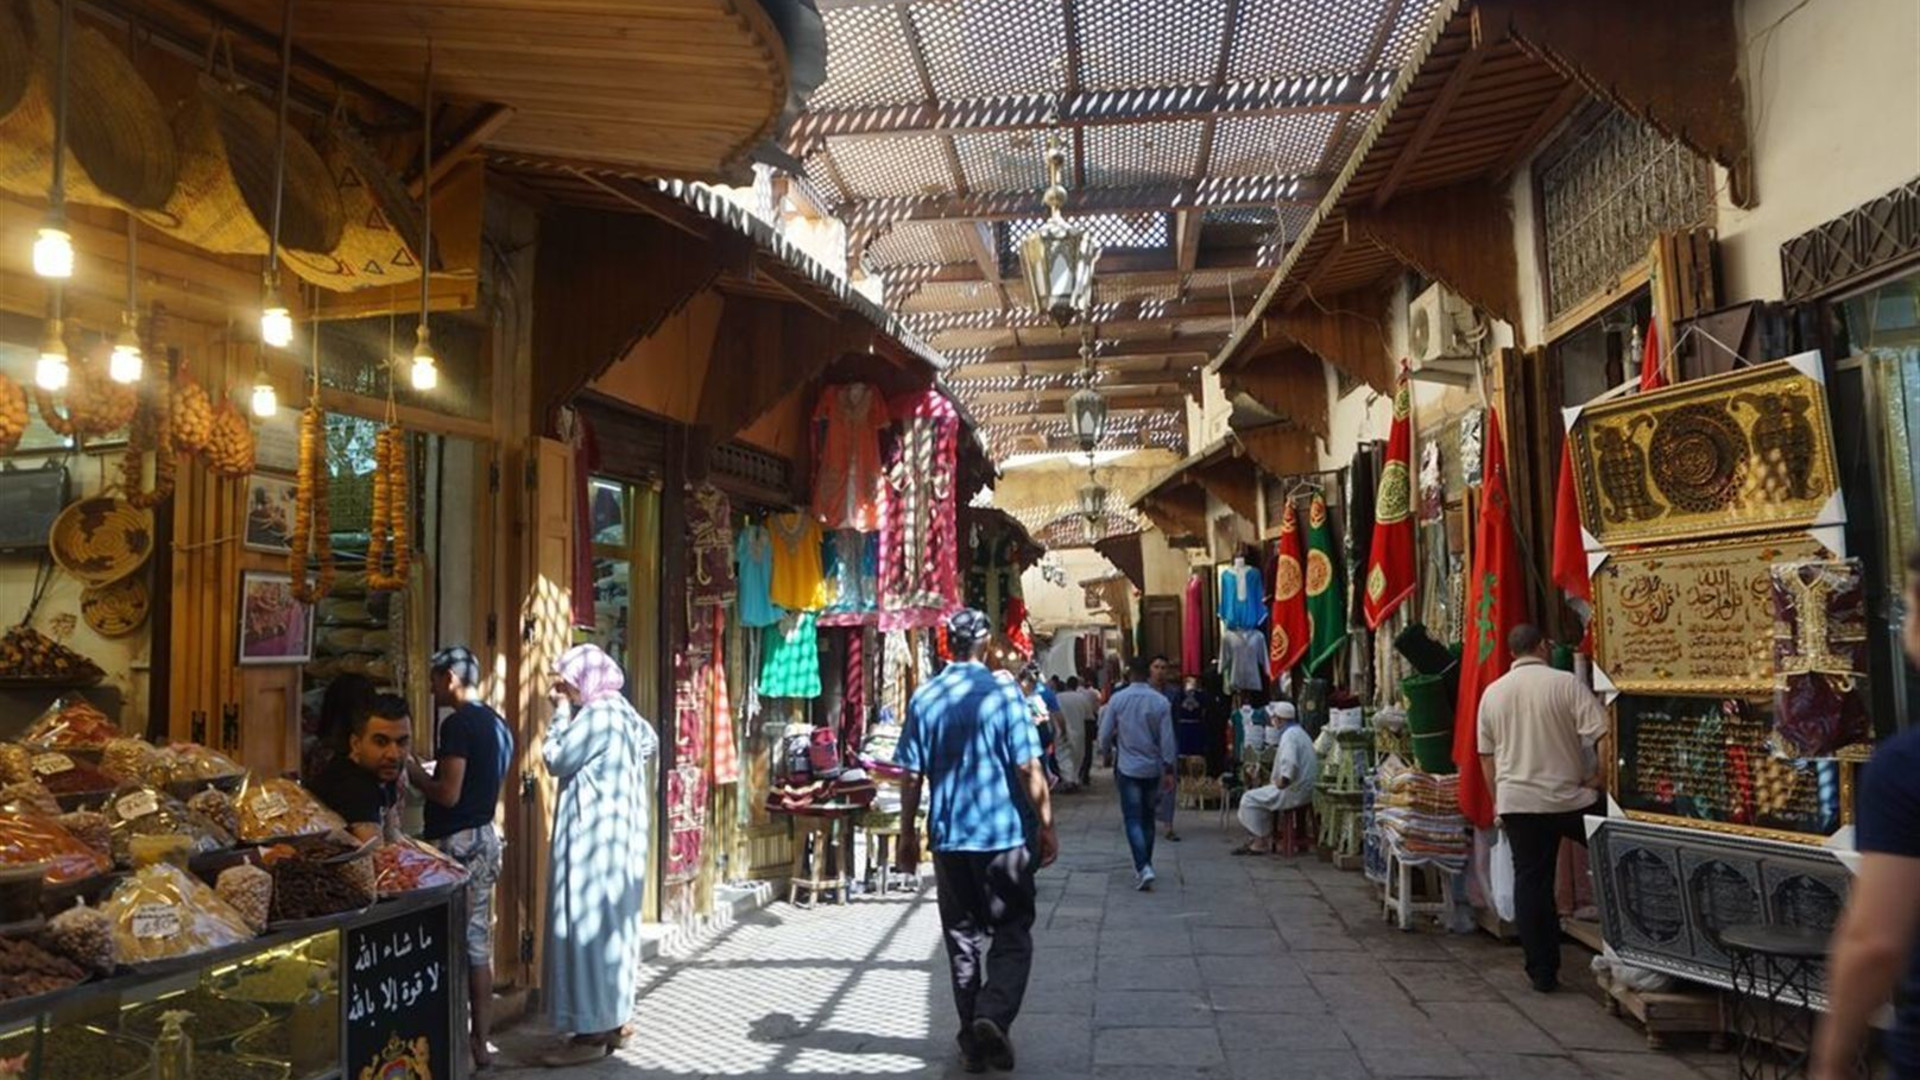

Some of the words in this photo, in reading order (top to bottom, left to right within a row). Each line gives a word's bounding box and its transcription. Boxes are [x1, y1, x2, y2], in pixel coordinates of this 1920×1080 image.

[383, 932, 413, 959] شاء
[418, 923, 433, 950] ما
[354, 934, 378, 972] الله
[401, 971, 424, 1006] قوة
[426, 962, 440, 991] لا
[348, 982, 376, 1027] بالله
